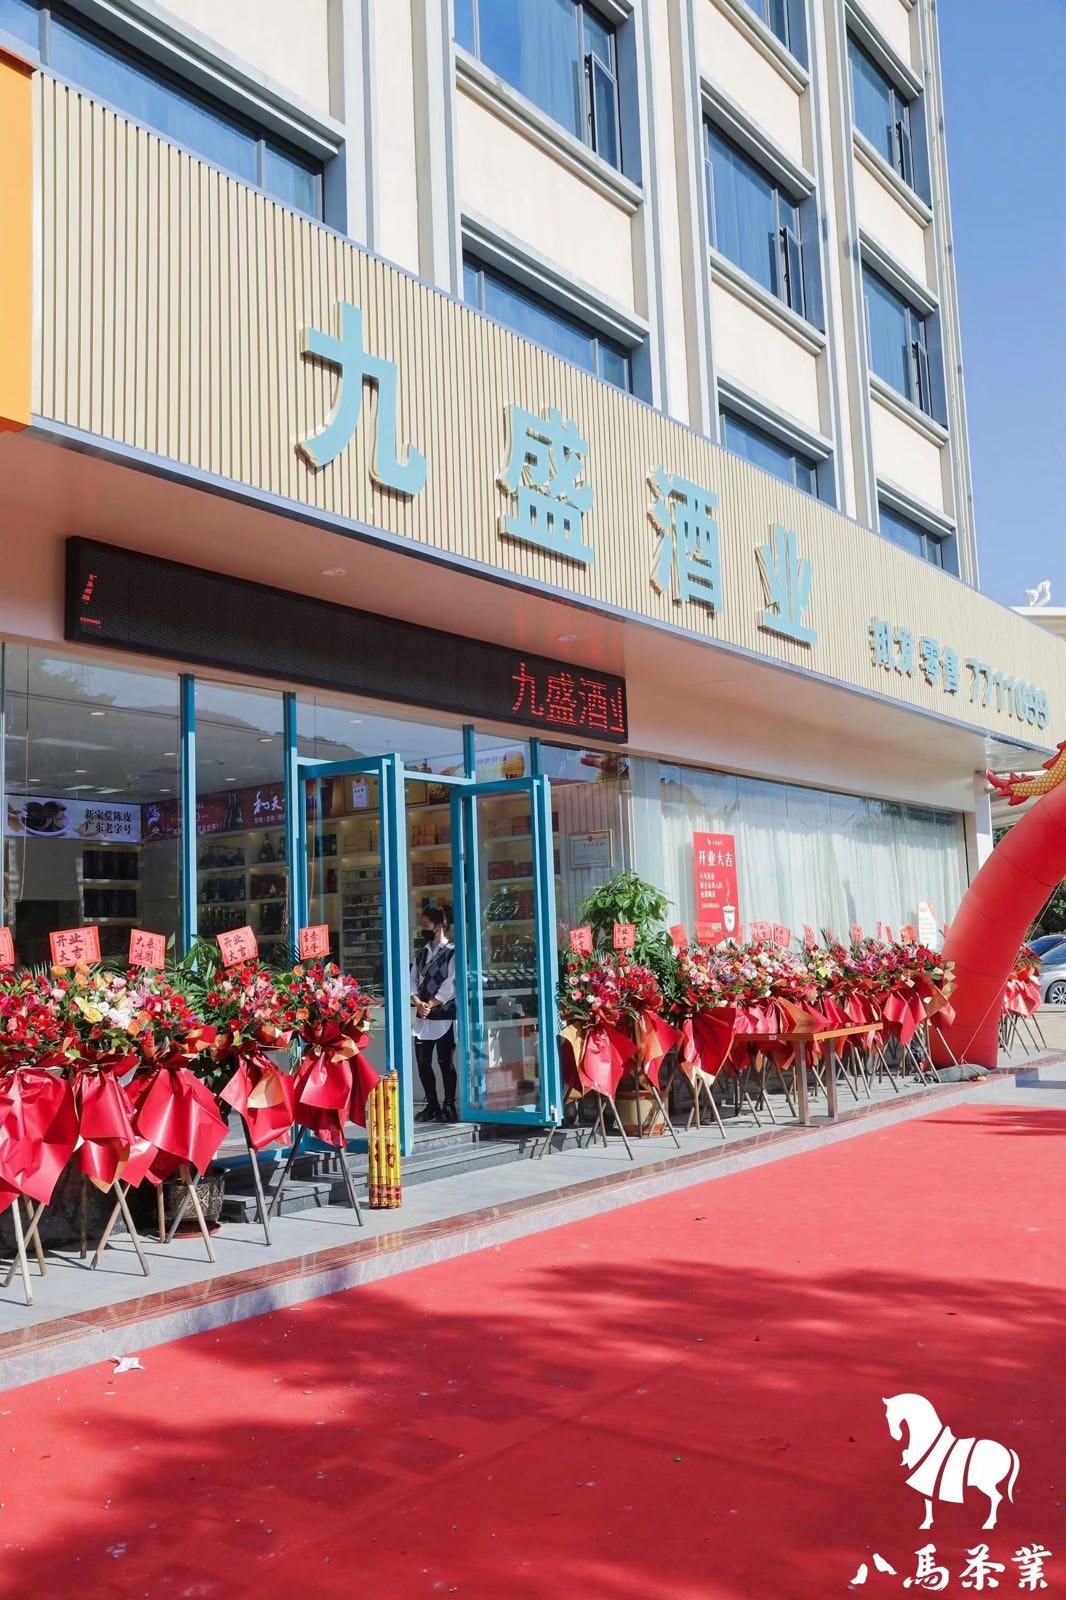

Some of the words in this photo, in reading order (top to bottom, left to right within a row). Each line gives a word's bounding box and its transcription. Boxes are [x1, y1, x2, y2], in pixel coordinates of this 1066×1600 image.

[296, 301, 817, 646] 九盛酒业
[85, 808, 132, 822] 新宝堂陈皮
[85, 821, 132, 834] 广东老字号
[698, 850, 733, 867] 开业大吉
